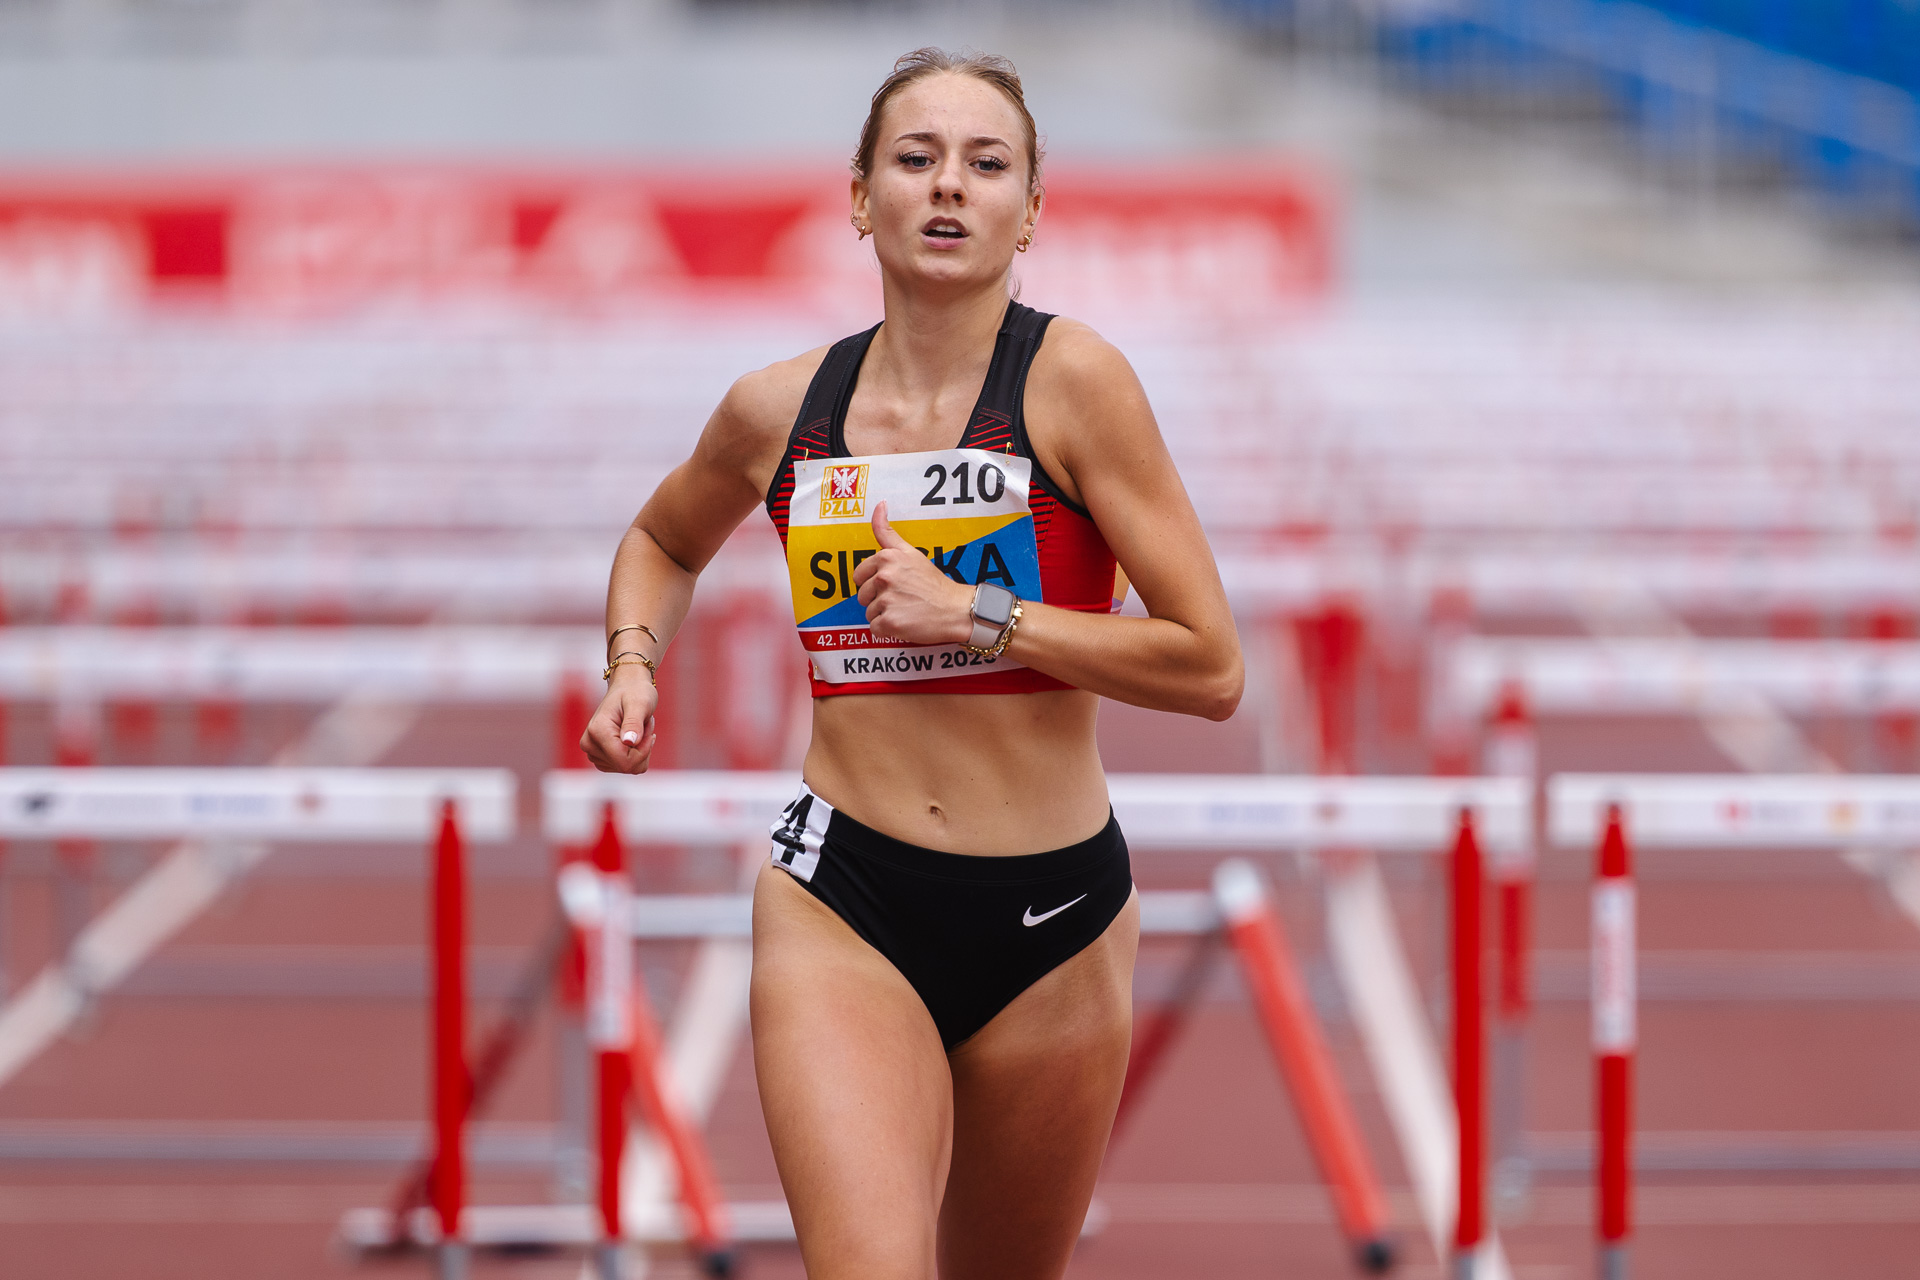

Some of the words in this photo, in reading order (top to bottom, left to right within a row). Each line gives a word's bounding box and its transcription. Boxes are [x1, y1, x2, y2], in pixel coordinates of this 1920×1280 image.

[921, 461, 1006, 506] 210
[822, 499, 862, 516] PZLA
[810, 542, 1016, 599] SIKA
[817, 633, 837, 647] 42.
[839, 632, 869, 645] PZLA
[843, 651, 934, 674] KRAKÓW
[771, 793, 815, 866] 4
